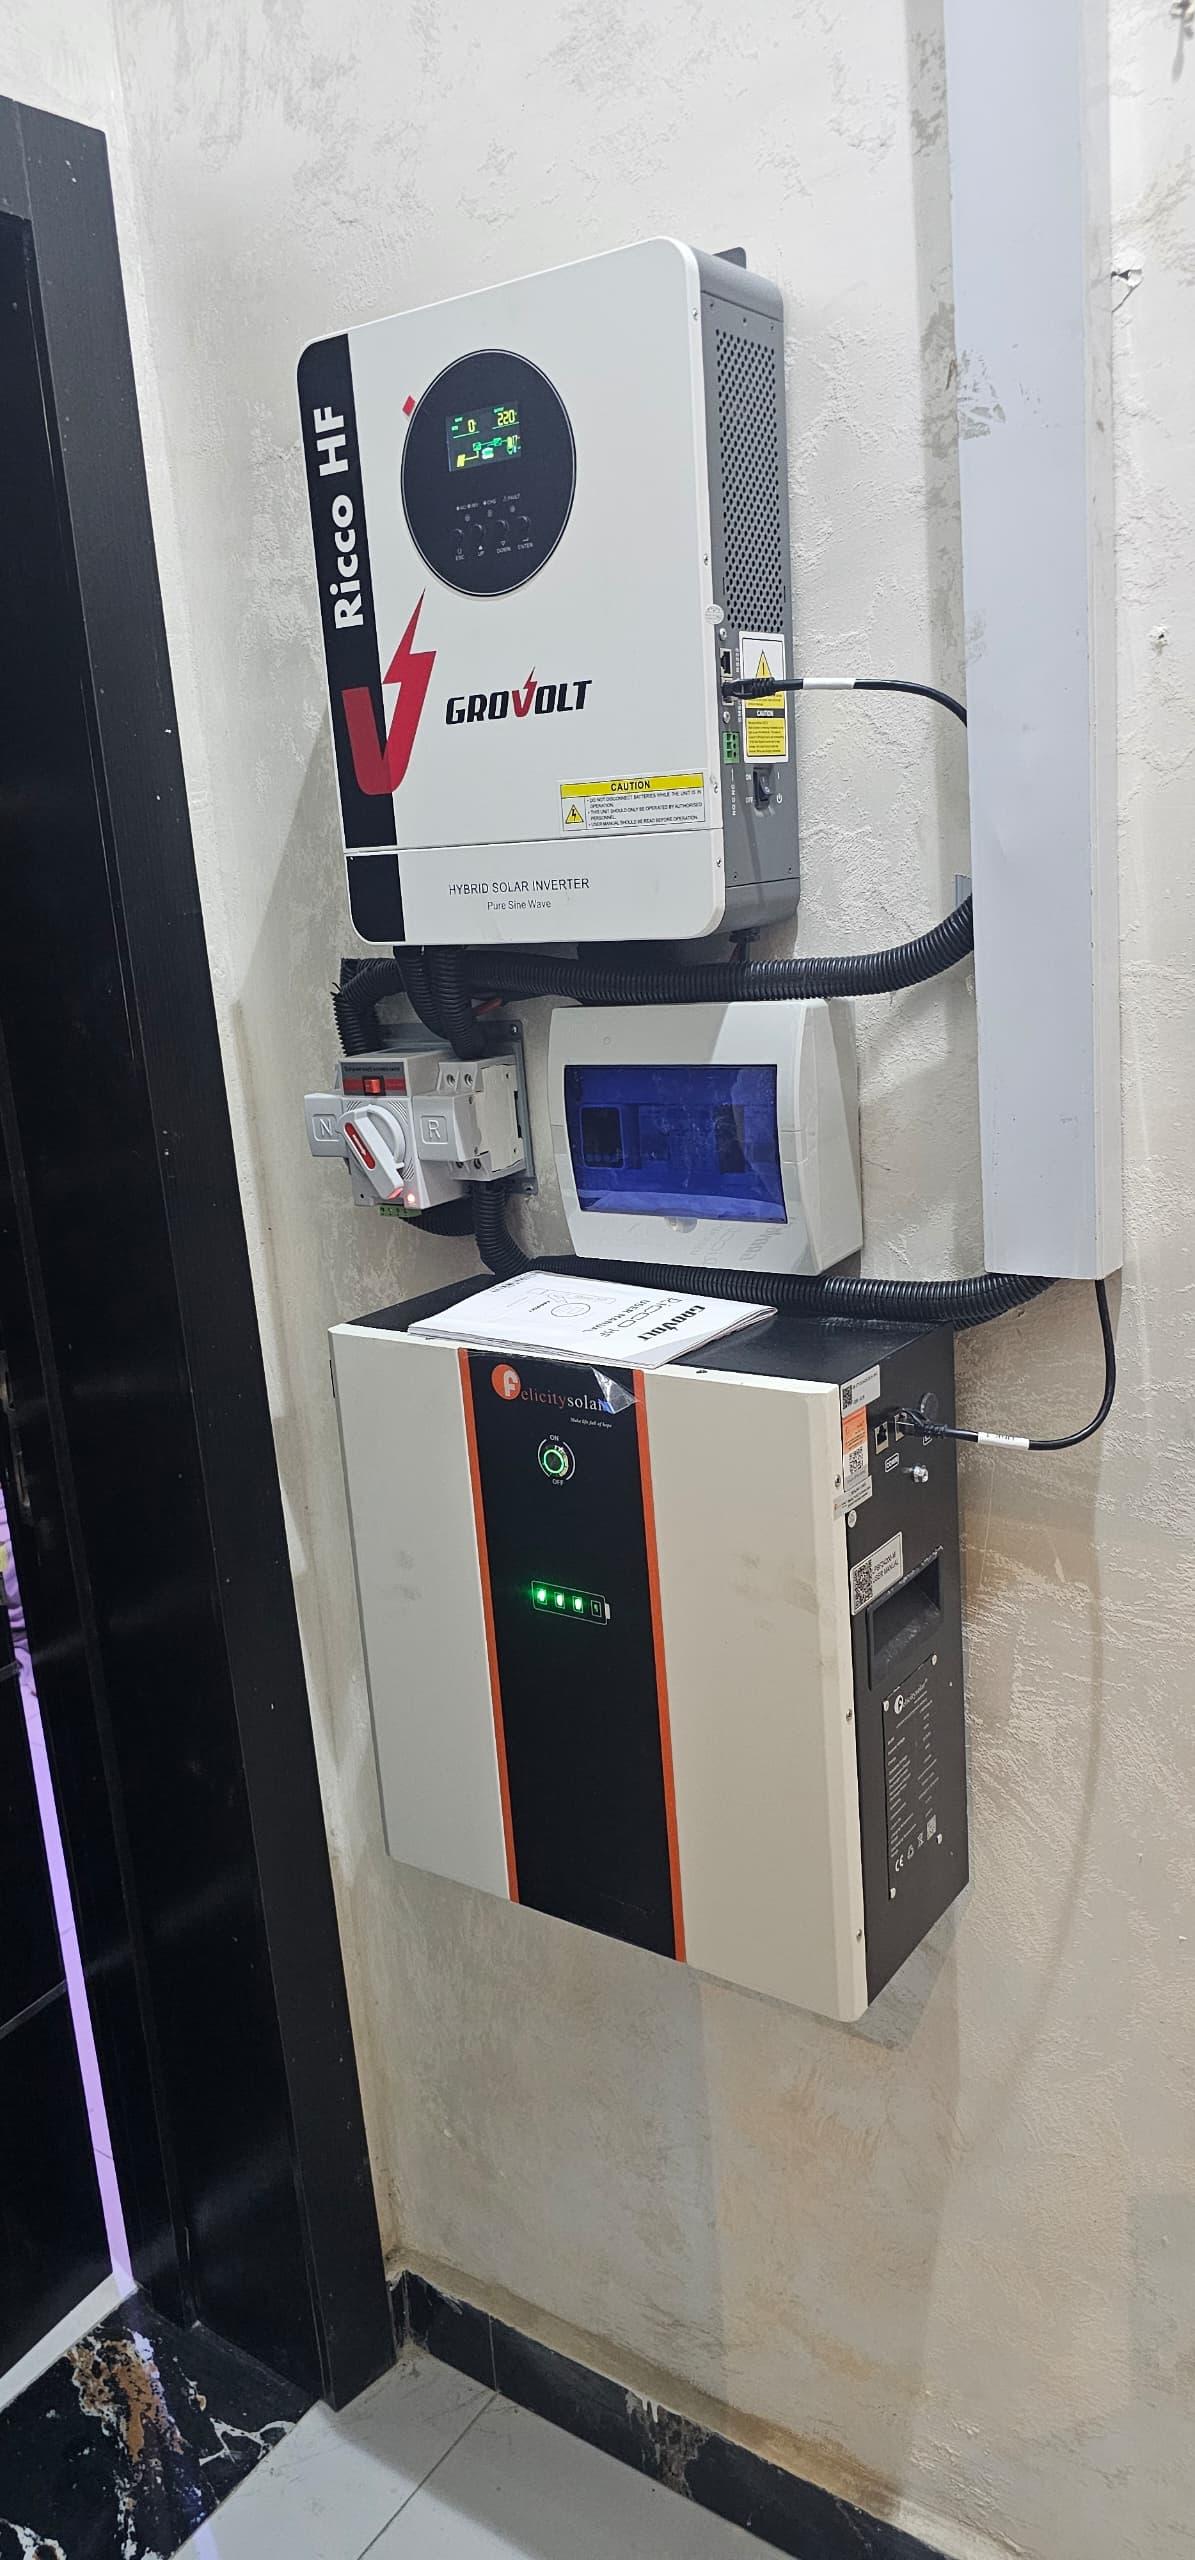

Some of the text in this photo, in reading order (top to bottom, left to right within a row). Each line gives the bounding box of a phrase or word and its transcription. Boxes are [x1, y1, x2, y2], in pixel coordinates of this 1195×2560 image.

[313, 406, 364, 629] Ricco HF
[445, 666, 592, 725] GROVOLT
[611, 780, 650, 791] CAUTION
[449, 878, 590, 895] HYBRID SOLAR INVERTER
[487, 899, 552, 911] Pure Sine Wave
[319, 1118, 333, 1136] N
[428, 1119, 441, 1139] R
[622, 1300, 650, 1314] USER
[637, 1305, 706, 1340] GROVOLT
